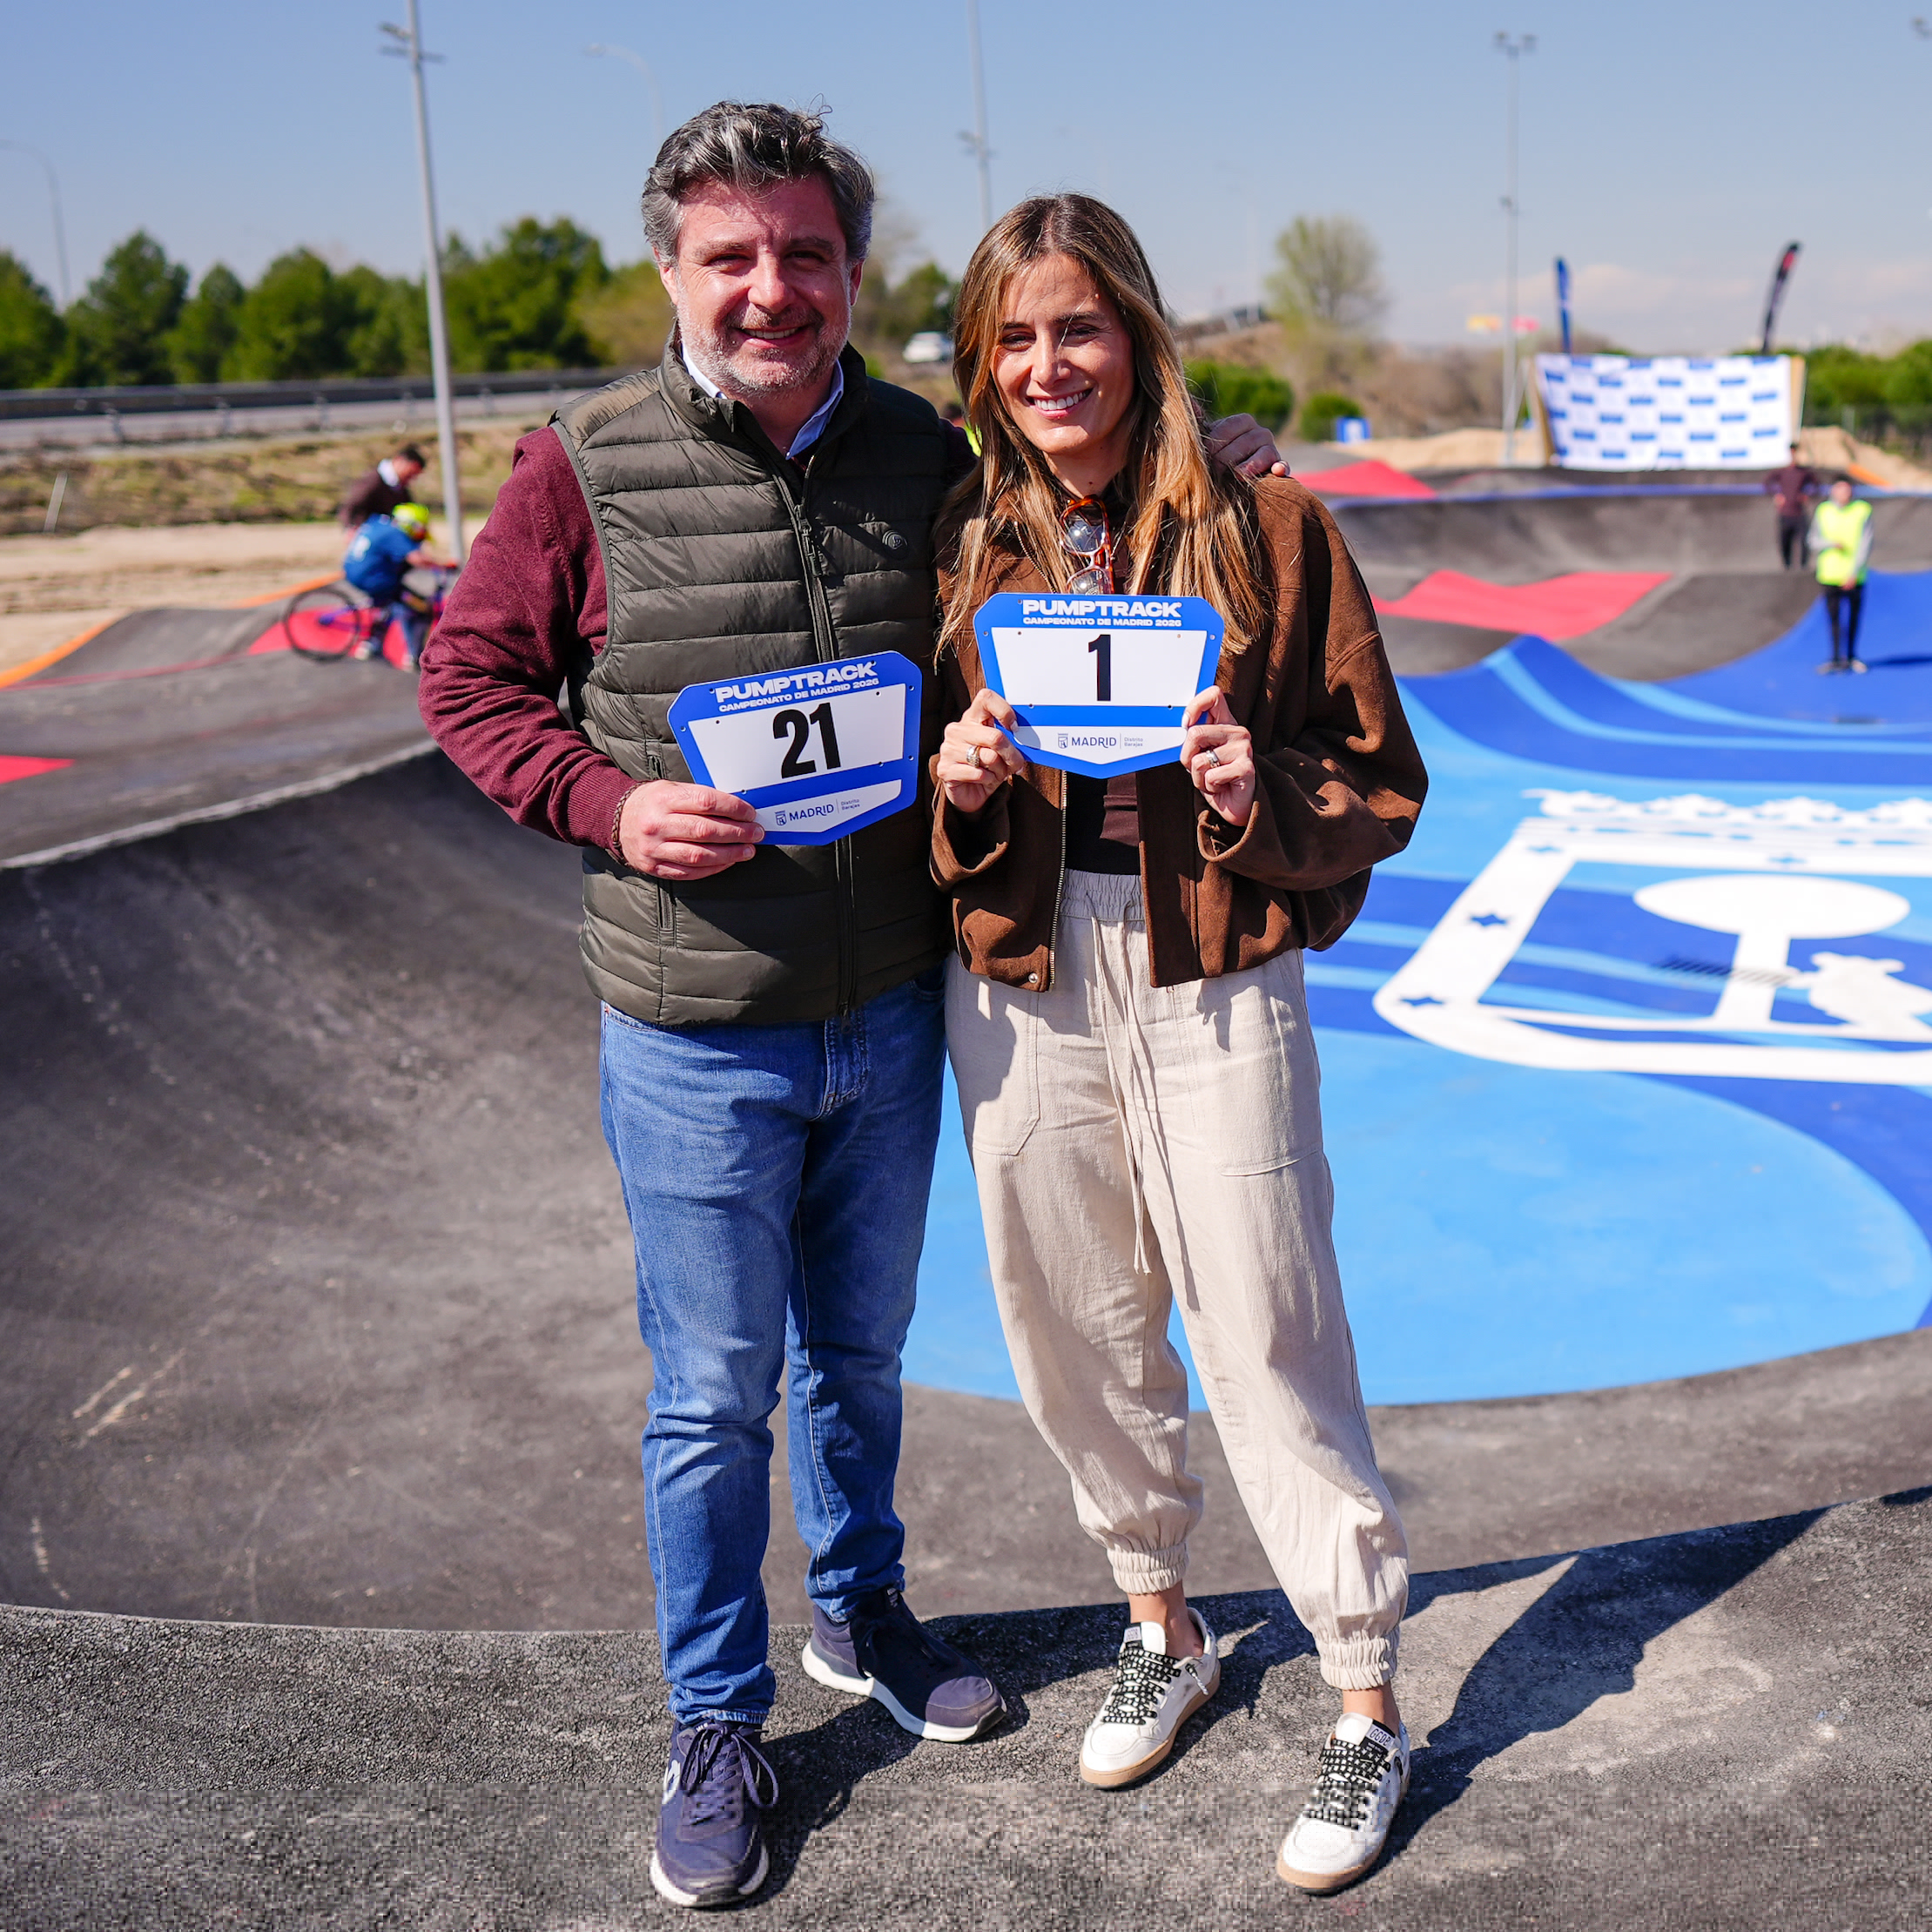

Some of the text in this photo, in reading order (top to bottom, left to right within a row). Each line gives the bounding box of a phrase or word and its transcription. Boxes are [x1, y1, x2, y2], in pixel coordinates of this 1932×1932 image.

[1022, 599, 1181, 618] PUMPTRACK
[1023, 617, 1095, 626] CAMPEONATO
[1088, 634, 1111, 702] 1
[715, 662, 878, 703] PUMPTRACK
[719, 677, 879, 713] CAMPEONATO DE MADRID 2026
[772, 702, 841, 780] 21
[1071, 737, 1117, 749] MADRID
[789, 804, 834, 822] MADRID
